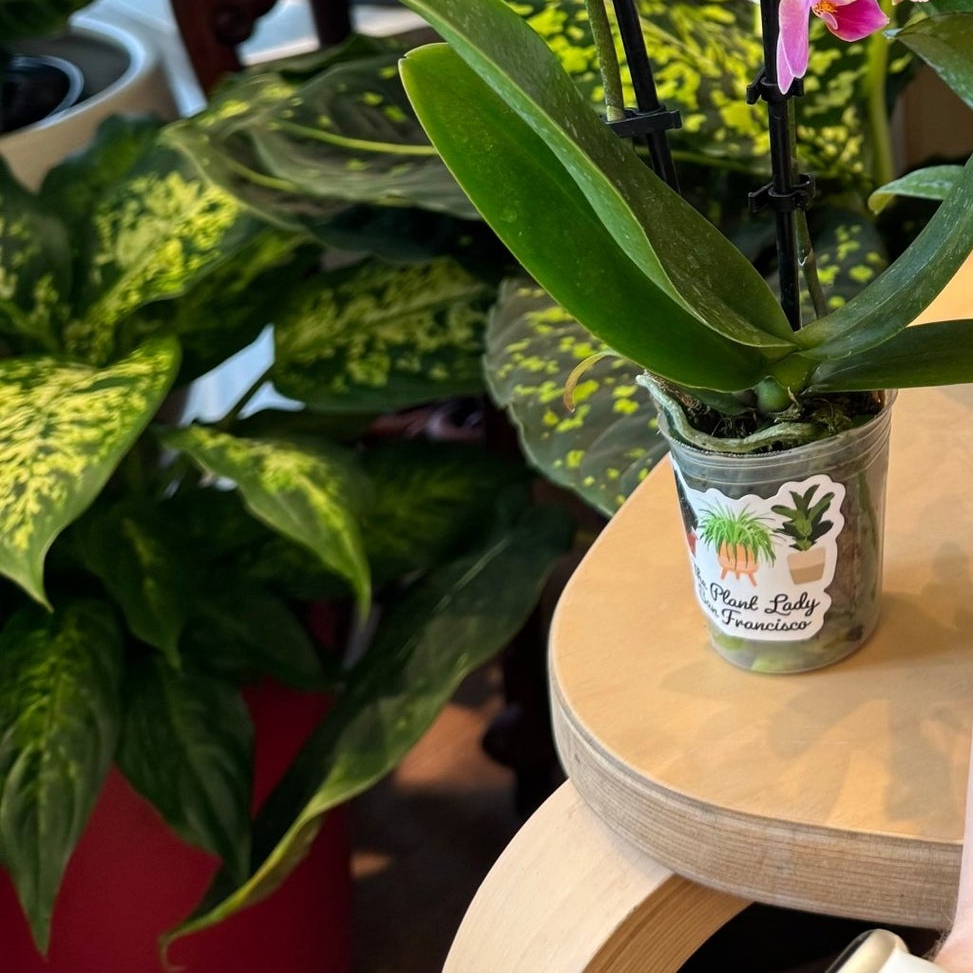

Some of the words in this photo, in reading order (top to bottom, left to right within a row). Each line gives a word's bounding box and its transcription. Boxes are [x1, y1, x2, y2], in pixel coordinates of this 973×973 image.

[710, 582, 759, 611] Plant
[764, 591, 821, 617] Lady
[721, 608, 812, 631] Francisco
